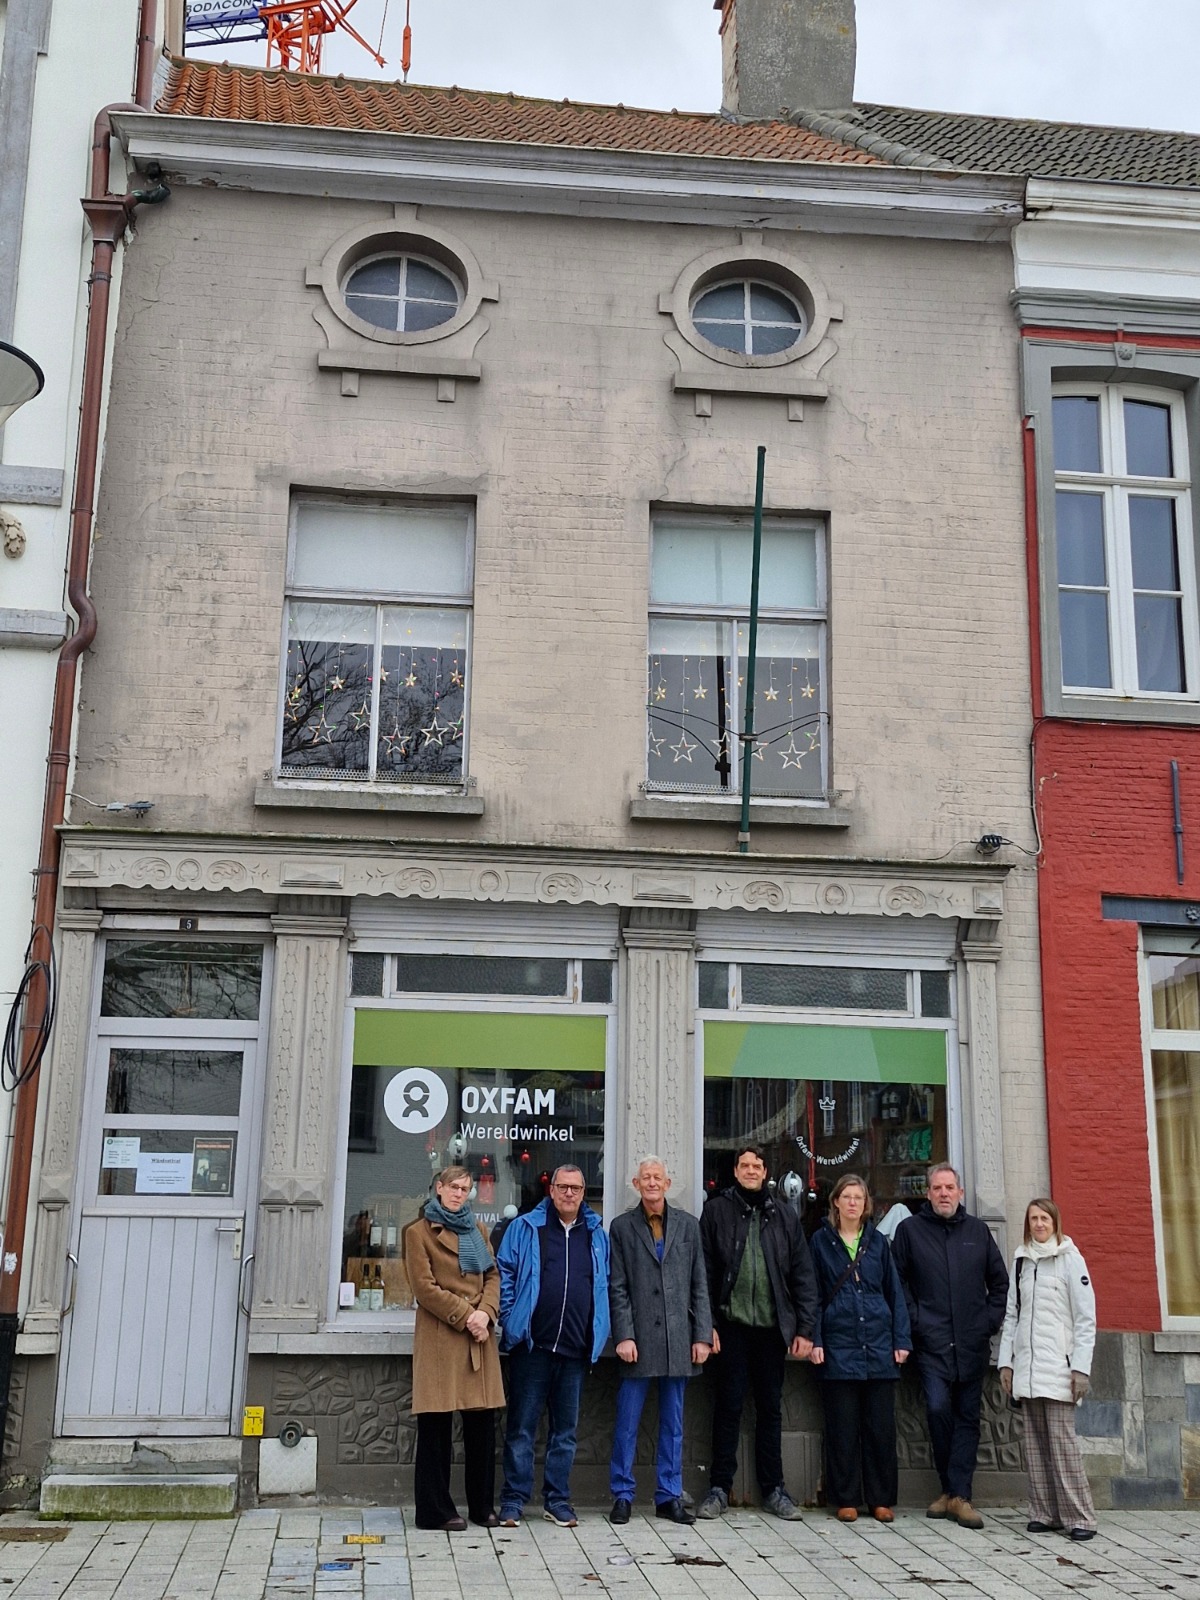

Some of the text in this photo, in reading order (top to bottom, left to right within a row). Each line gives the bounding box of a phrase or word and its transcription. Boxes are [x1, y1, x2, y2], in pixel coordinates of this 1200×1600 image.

[186, 919, 192, 930] 5
[461, 1086, 556, 1115] OXFAM
[460, 1122, 574, 1142] Wereldwinkel
